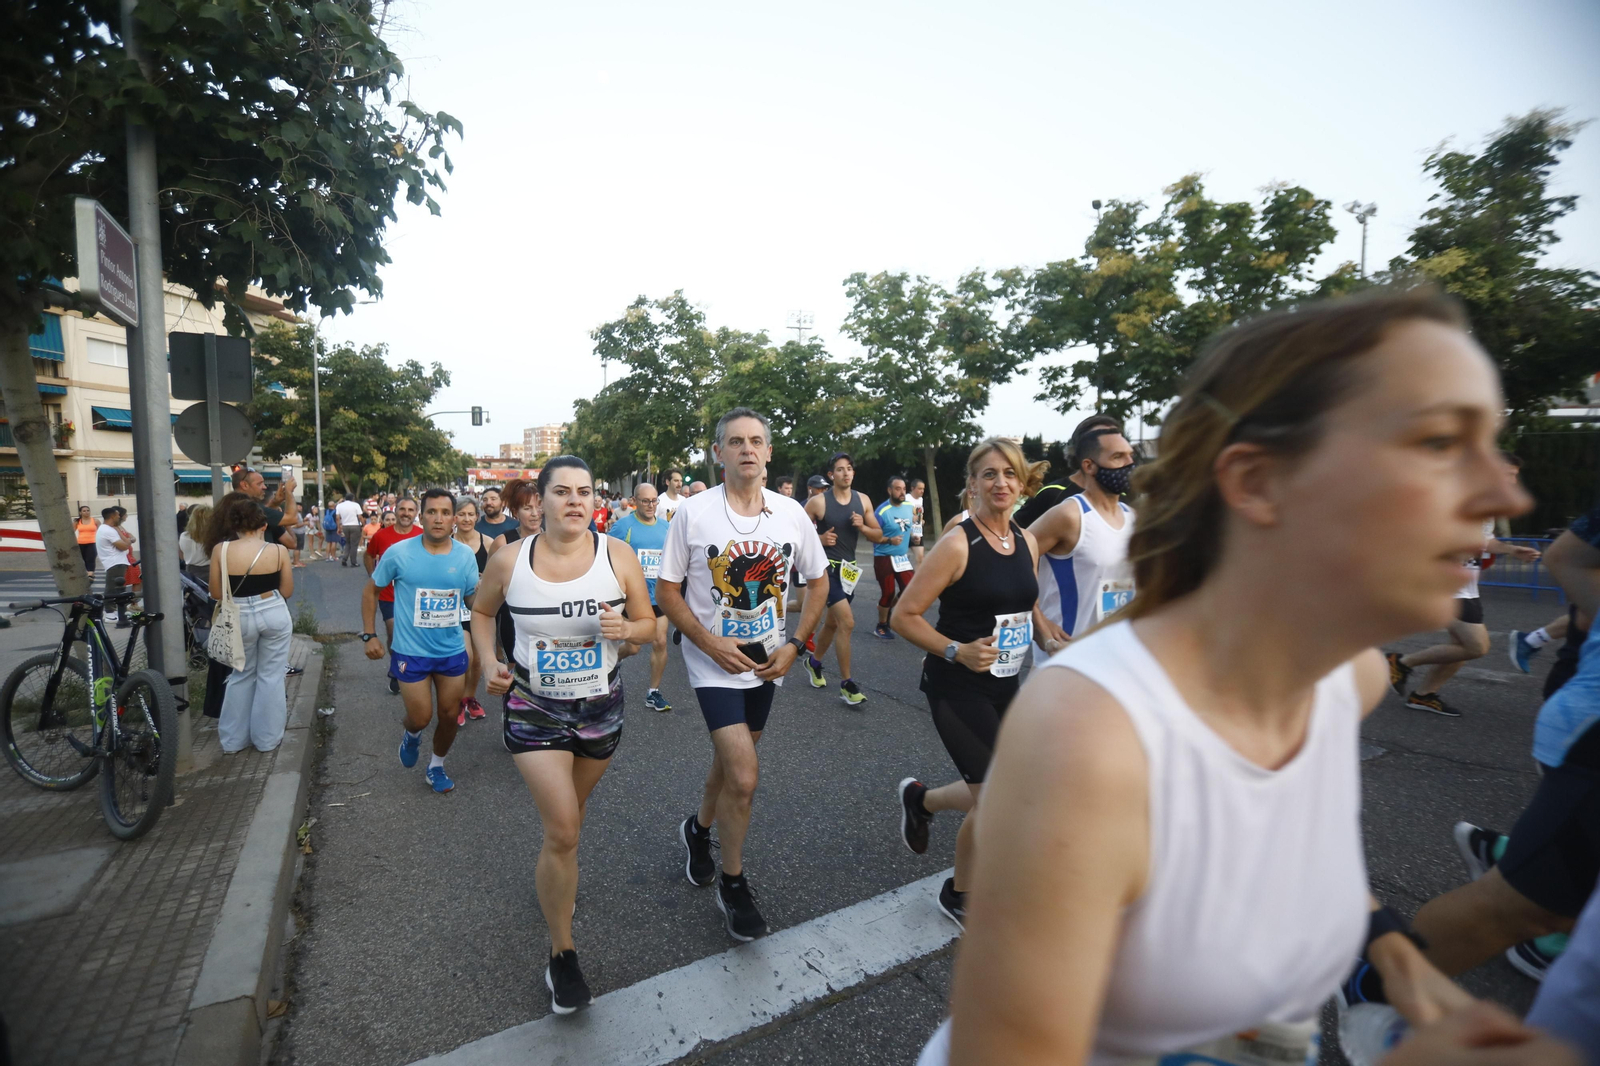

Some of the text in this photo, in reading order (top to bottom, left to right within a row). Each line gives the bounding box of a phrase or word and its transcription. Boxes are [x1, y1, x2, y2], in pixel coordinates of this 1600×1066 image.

[100, 249, 133, 289] Pintor Antonio
[100, 273, 136, 312] Rodríguez Luna
[424, 598, 454, 610] 1732
[561, 598, 597, 618] 076
[727, 614, 770, 637] 2336
[543, 650, 596, 670] 2630
[557, 674, 599, 685] laArruzafa
